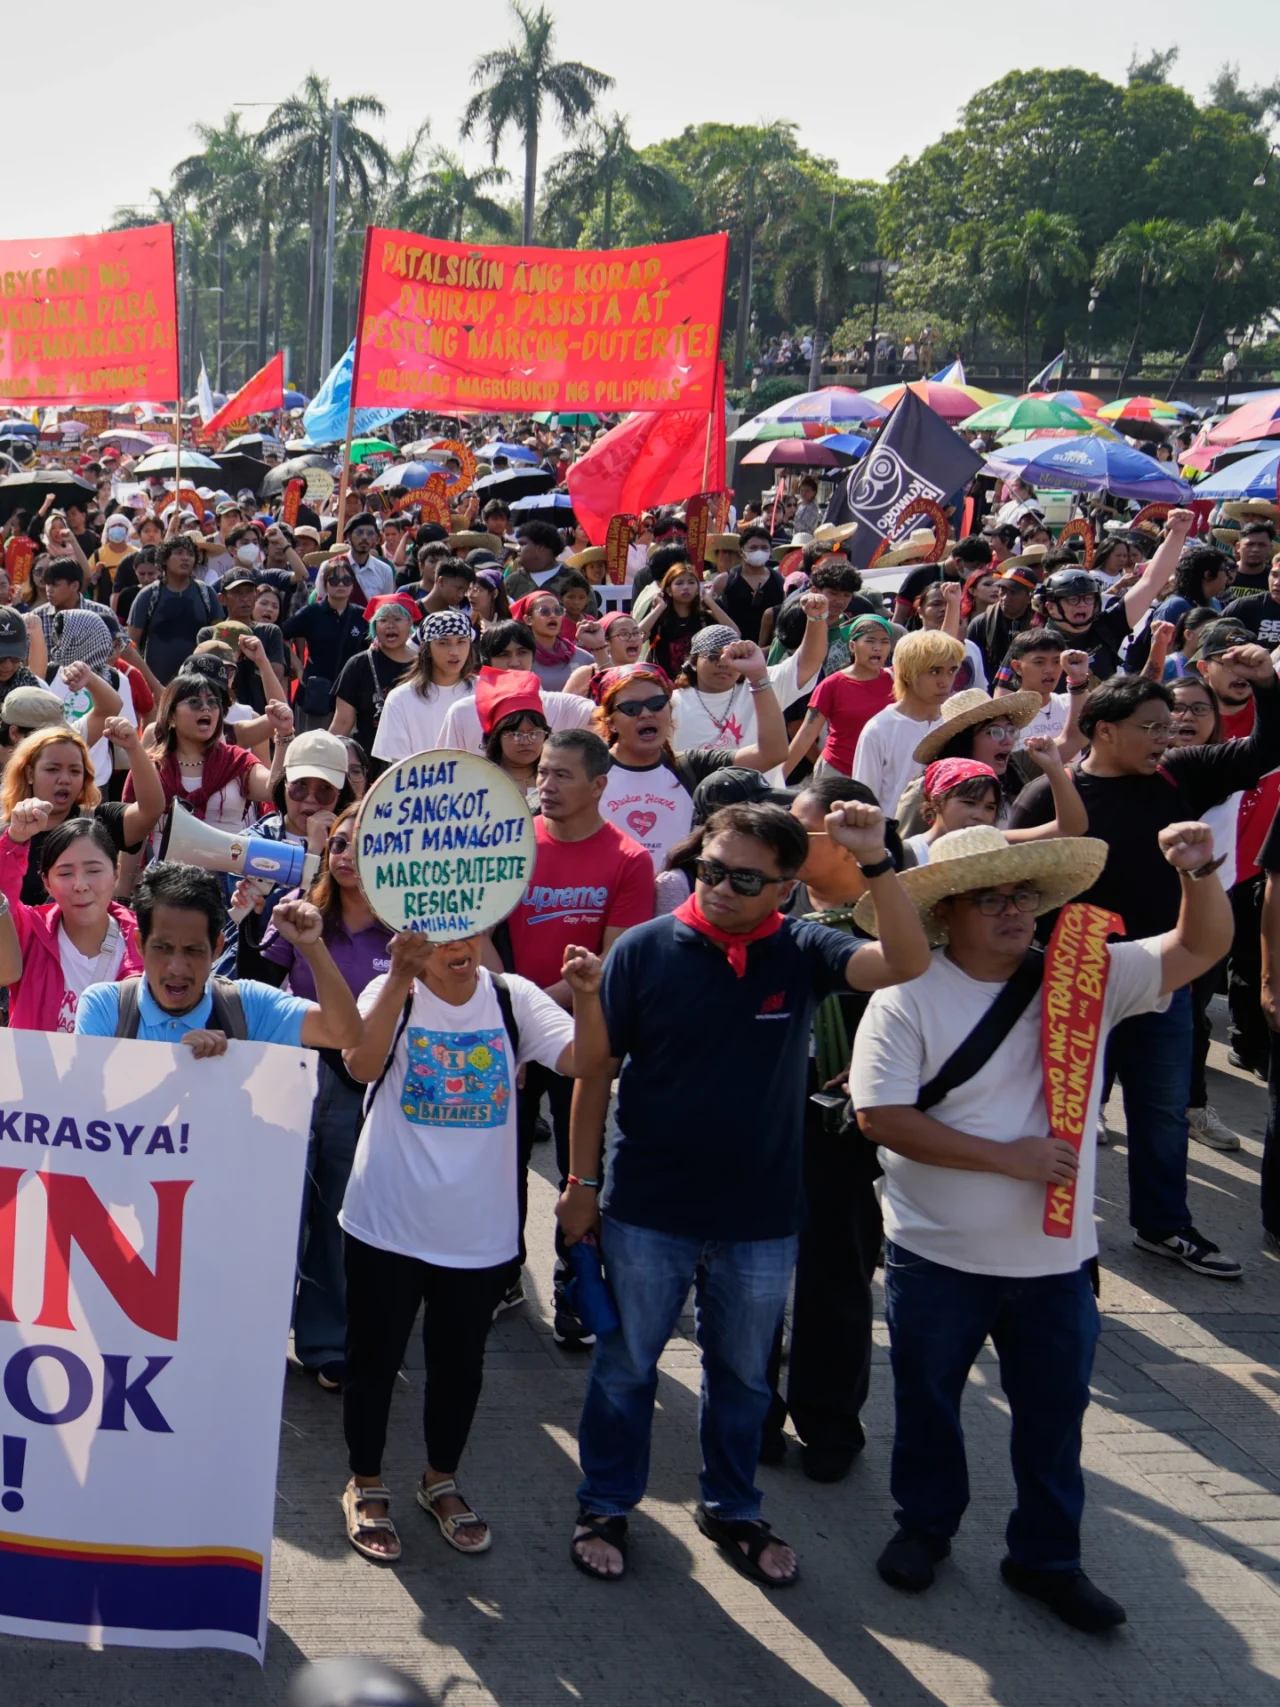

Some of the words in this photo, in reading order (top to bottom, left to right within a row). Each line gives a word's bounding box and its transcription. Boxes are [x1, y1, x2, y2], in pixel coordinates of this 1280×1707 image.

[99, 260, 130, 289] NG
[381, 243, 504, 290] PATALSIKIN
[511, 262, 564, 293] ANG
[574, 258, 667, 291] KORAP,
[97, 290, 156, 325] PARA
[399, 285, 504, 324] PAHIRAP,
[513, 294, 624, 326] PASISTA
[632, 290, 670, 323] AT
[14, 322, 173, 363] DEMOKRASYA!
[363, 315, 459, 358] PESTENG
[467, 324, 715, 362] MARCOS-DUTERTE!
[36, 375, 56, 395] NG
[65, 365, 148, 392] PILIPINAS
[376, 369, 451, 396] KILUSANG
[455, 376, 559, 401] MAGBUBUKID
[565, 383, 590, 401] NG
[595, 378, 681, 402] PILIPINAS
[394, 760, 458, 793] LAHAT
[374, 802, 393, 819] NG
[397, 789, 491, 825] SANGKOT,
[363, 829, 414, 858] DAPAT
[421, 817, 525, 851] MANAGOT!
[376, 856, 527, 889] MARCOS-DUTERTE
[403, 887, 485, 919] RESIGN!
[1047, 902, 1086, 1024] TRANSITION
[1075, 907, 1117, 1000] BAYAN!
[1079, 999, 1089, 1019] NG
[1048, 1023, 1068, 1063] ANG
[449, 1055, 459, 1068] I
[1065, 1022, 1095, 1135] COUNCIL
[421, 1104, 488, 1121] BATANES
[1050, 1071, 1066, 1132] ITAYO
